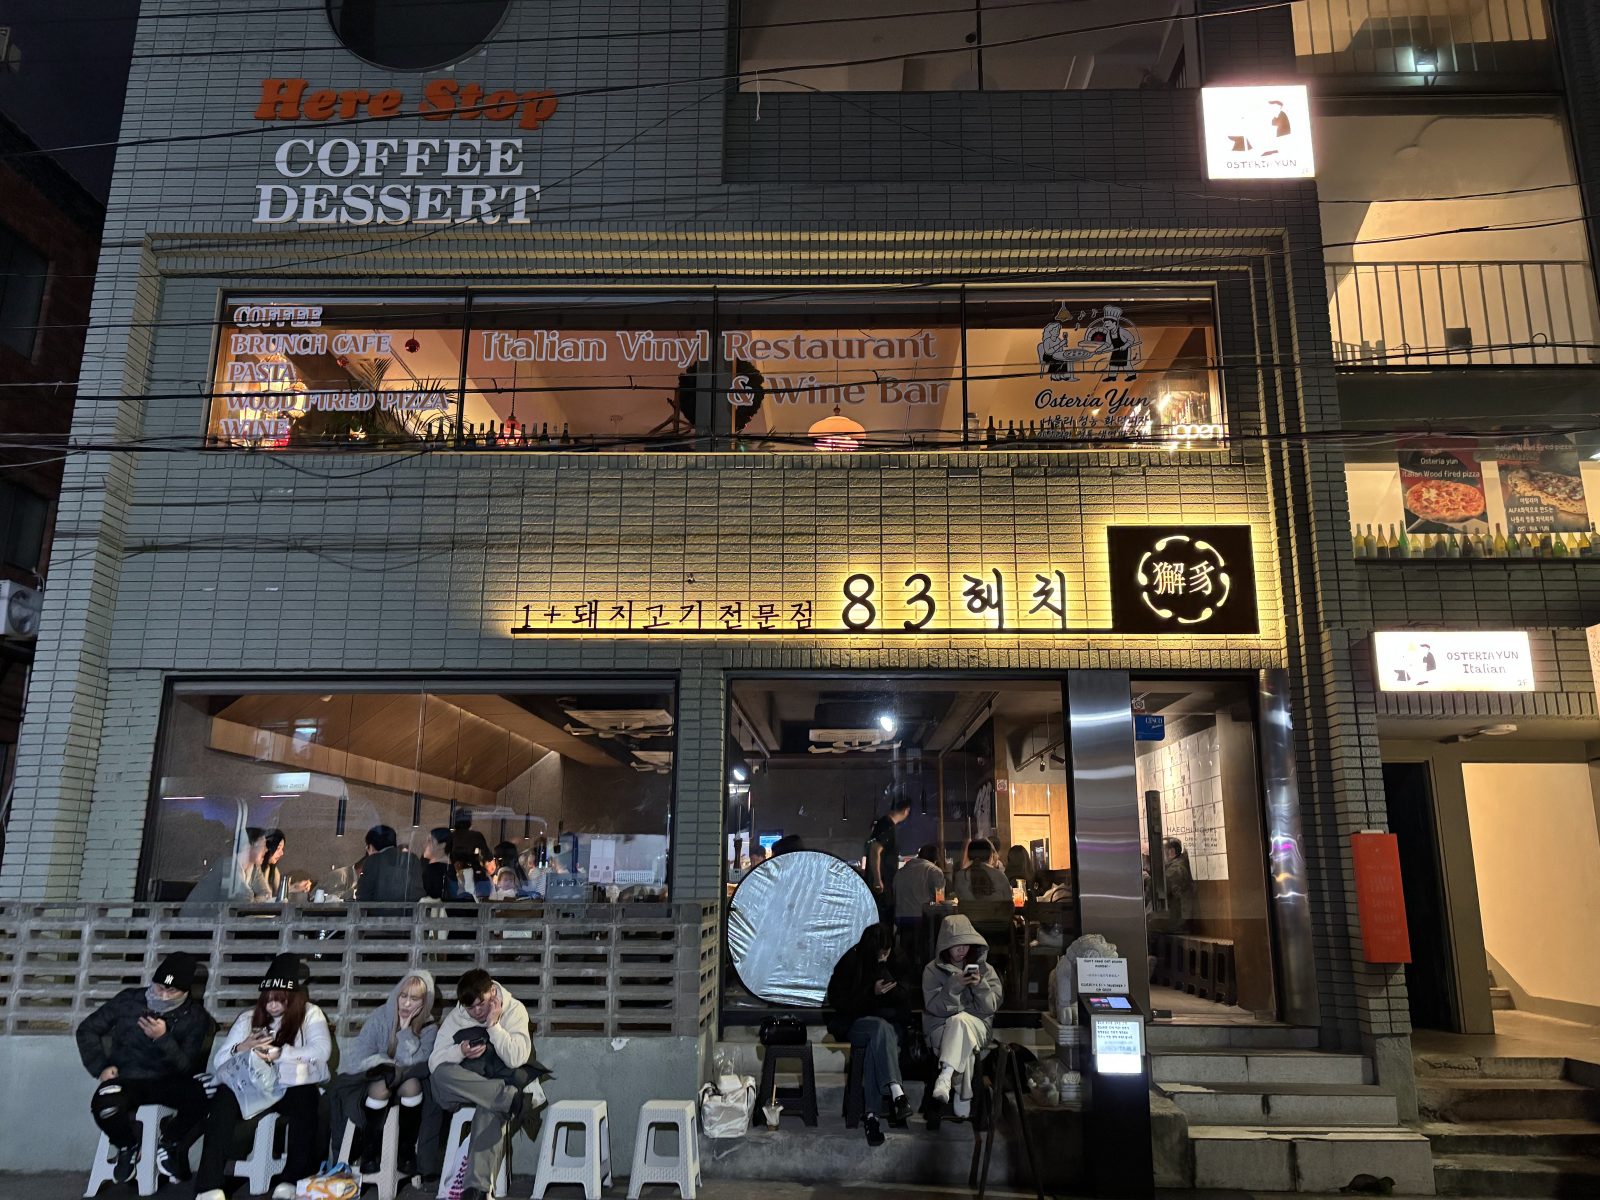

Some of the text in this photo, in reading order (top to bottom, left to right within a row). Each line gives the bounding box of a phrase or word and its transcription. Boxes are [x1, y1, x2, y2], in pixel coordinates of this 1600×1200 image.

[254, 78, 559, 130] Here Stop
[274, 138, 524, 178] COFFEE
[251, 184, 541, 225] DESSERT
[233, 306, 323, 328] COFFEE
[230, 333, 391, 355] BRUNCH CAFE
[482, 330, 938, 368] Italian Vinyl Restaurant
[227, 361, 297, 382] PASTA
[225, 390, 450, 412] WOOD FIRED PIZZA
[726, 375, 948, 406] & Wine Bar
[1035, 388, 1151, 414] Osteria Yun
[220, 418, 290, 438] WINE
[1172, 424, 1224, 446] open
[1420, 457, 1459, 466] Osteria yun
[1444, 470, 1461, 478] fired
[1462, 471, 1480, 479] pizza
[1462, 663, 1507, 674] Italian
